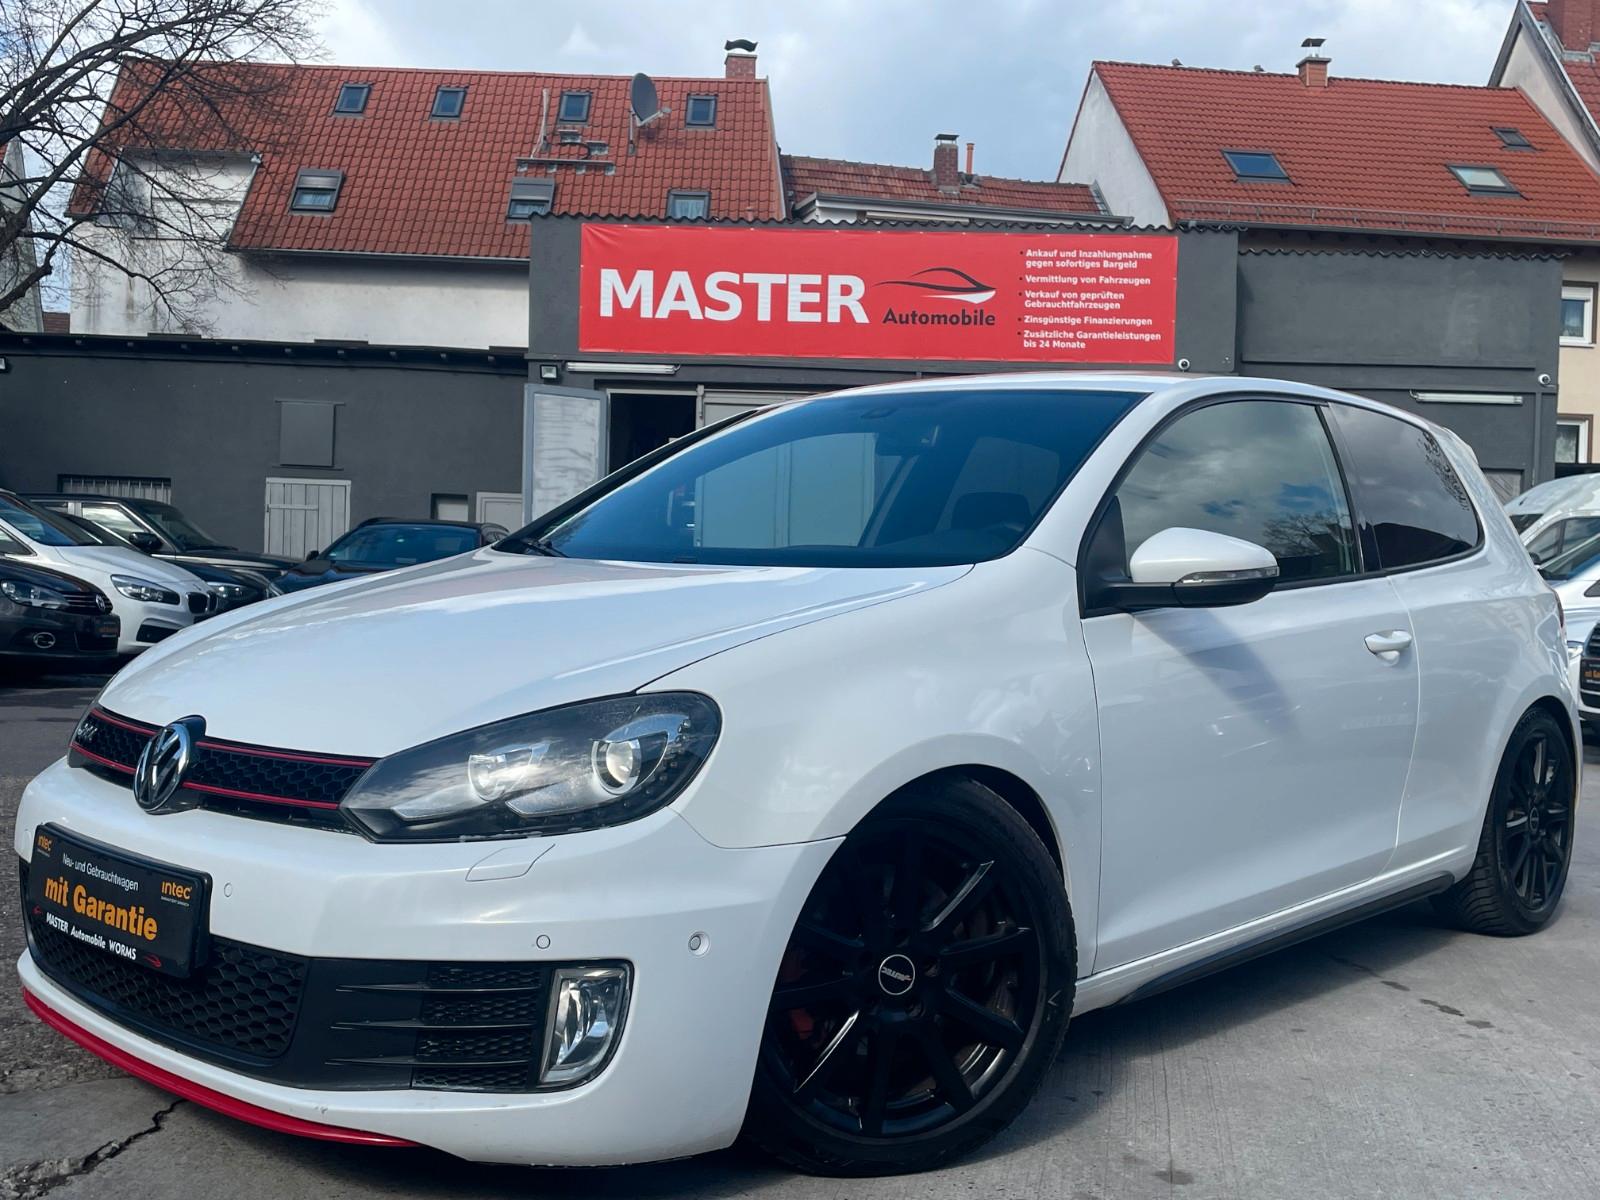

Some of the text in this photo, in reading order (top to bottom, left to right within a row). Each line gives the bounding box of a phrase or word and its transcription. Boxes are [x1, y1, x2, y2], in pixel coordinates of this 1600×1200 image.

[1026, 249, 1152, 260] Ankauf und Inzahlungnahme
[1056, 260, 1100, 269] sofortiges
[1103, 260, 1138, 270] Bargeld
[1025, 275, 1078, 285] Vermittlung
[1099, 276, 1150, 286] Fahrzeugen
[599, 268, 870, 324] MASTER
[1080, 291, 1124, 300] geprüften
[1024, 300, 1120, 310] Gebrauchtfahrzeugen
[882, 308, 996, 326] Automobile
[1024, 315, 1152, 327] Zinsgünstige Finanzierungen
[1024, 330, 1161, 341] Zusätzliche Garantieleistungen
[62, 853, 74, 868] Neu-
[75, 859, 86, 872] und
[86, 862, 139, 892] Gebrauchtwagen
[45, 876, 158, 941] mit Garantie
[46, 912, 137, 960] MASTER Automobile WORMS
